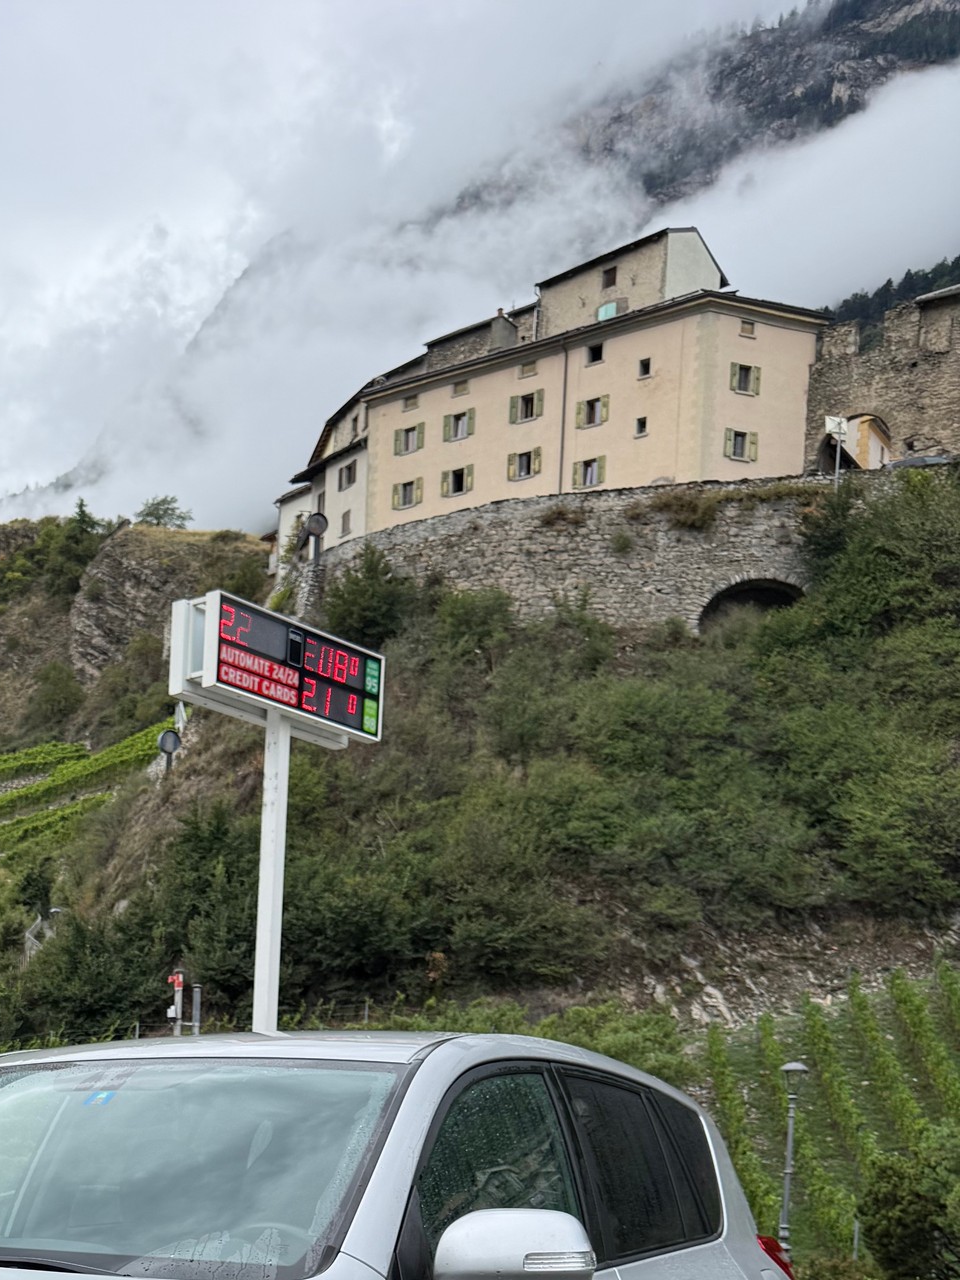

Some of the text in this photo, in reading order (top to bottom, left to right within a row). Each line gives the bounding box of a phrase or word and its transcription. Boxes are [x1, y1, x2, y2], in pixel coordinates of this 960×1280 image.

[220, 644, 300, 688] AUTOMATE 24/24
[220, 665, 298, 705] CREDIT CARDS
[365, 676, 378, 693] 95
